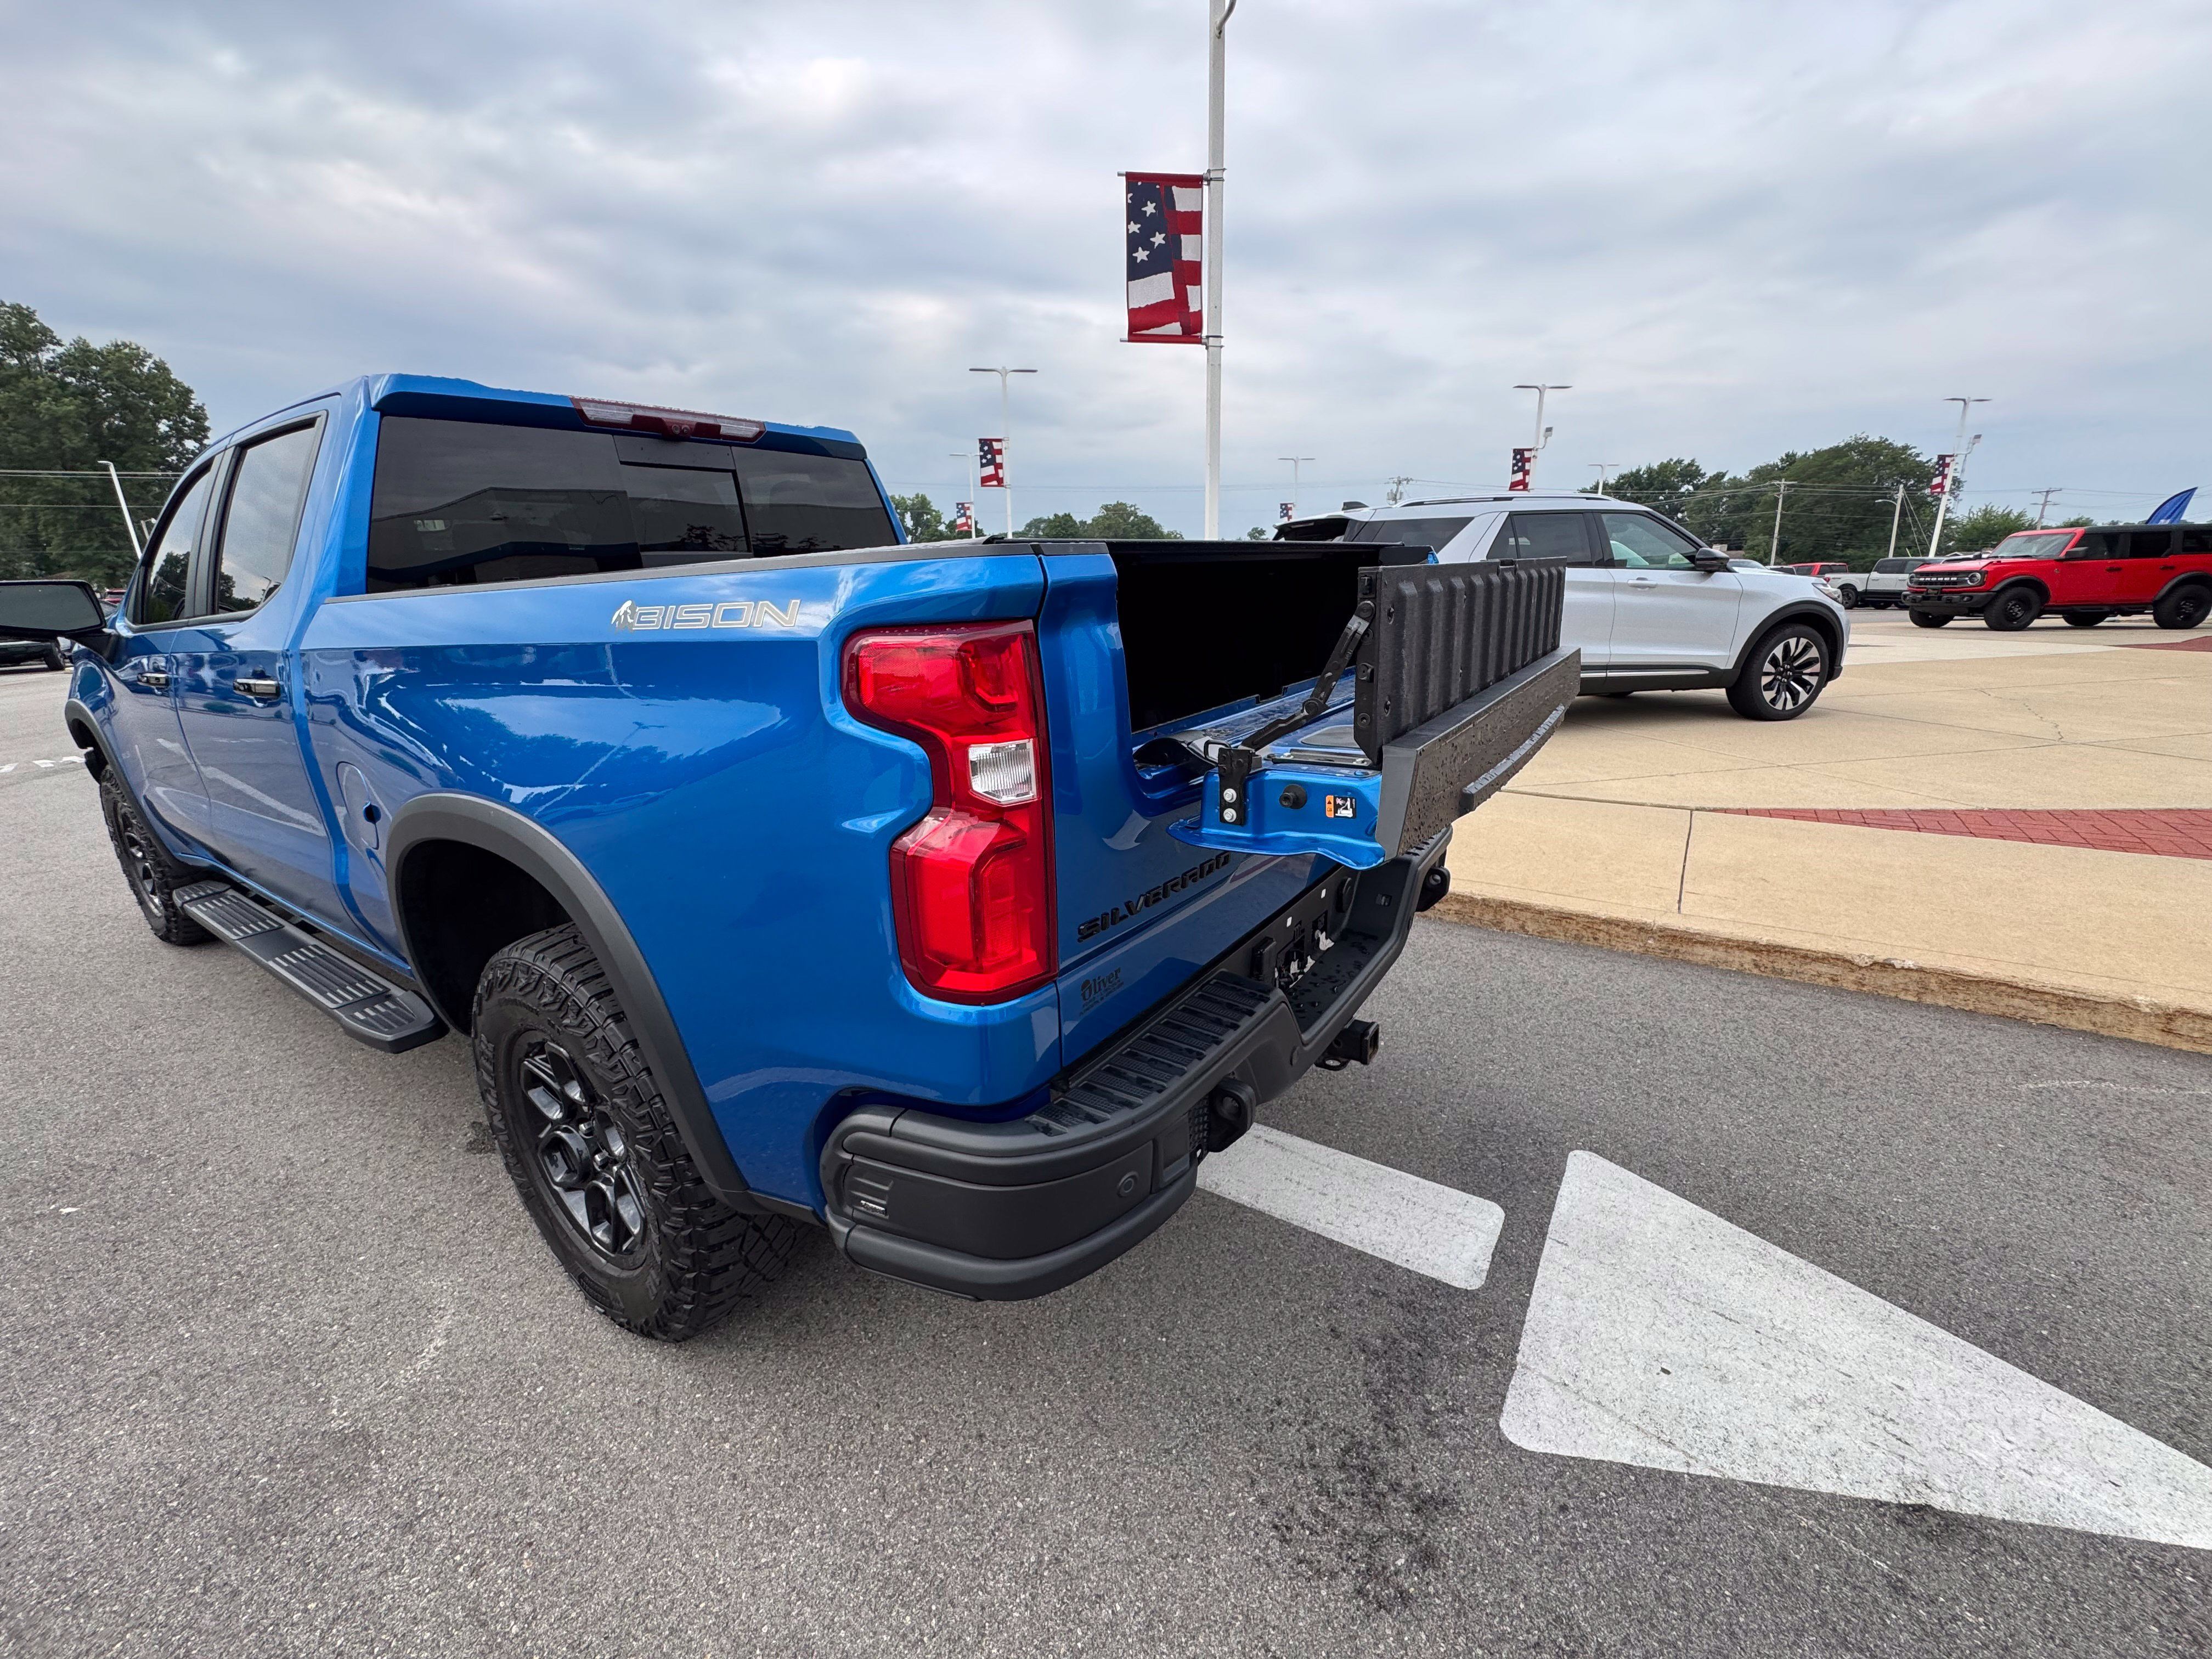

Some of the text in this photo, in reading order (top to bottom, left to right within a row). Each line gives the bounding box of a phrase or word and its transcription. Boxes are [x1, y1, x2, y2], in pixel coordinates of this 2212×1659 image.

[633, 599, 801, 630] BISON
[1077, 851, 1231, 943] SILVERADO
[1081, 967, 1121, 1001] Oliver
